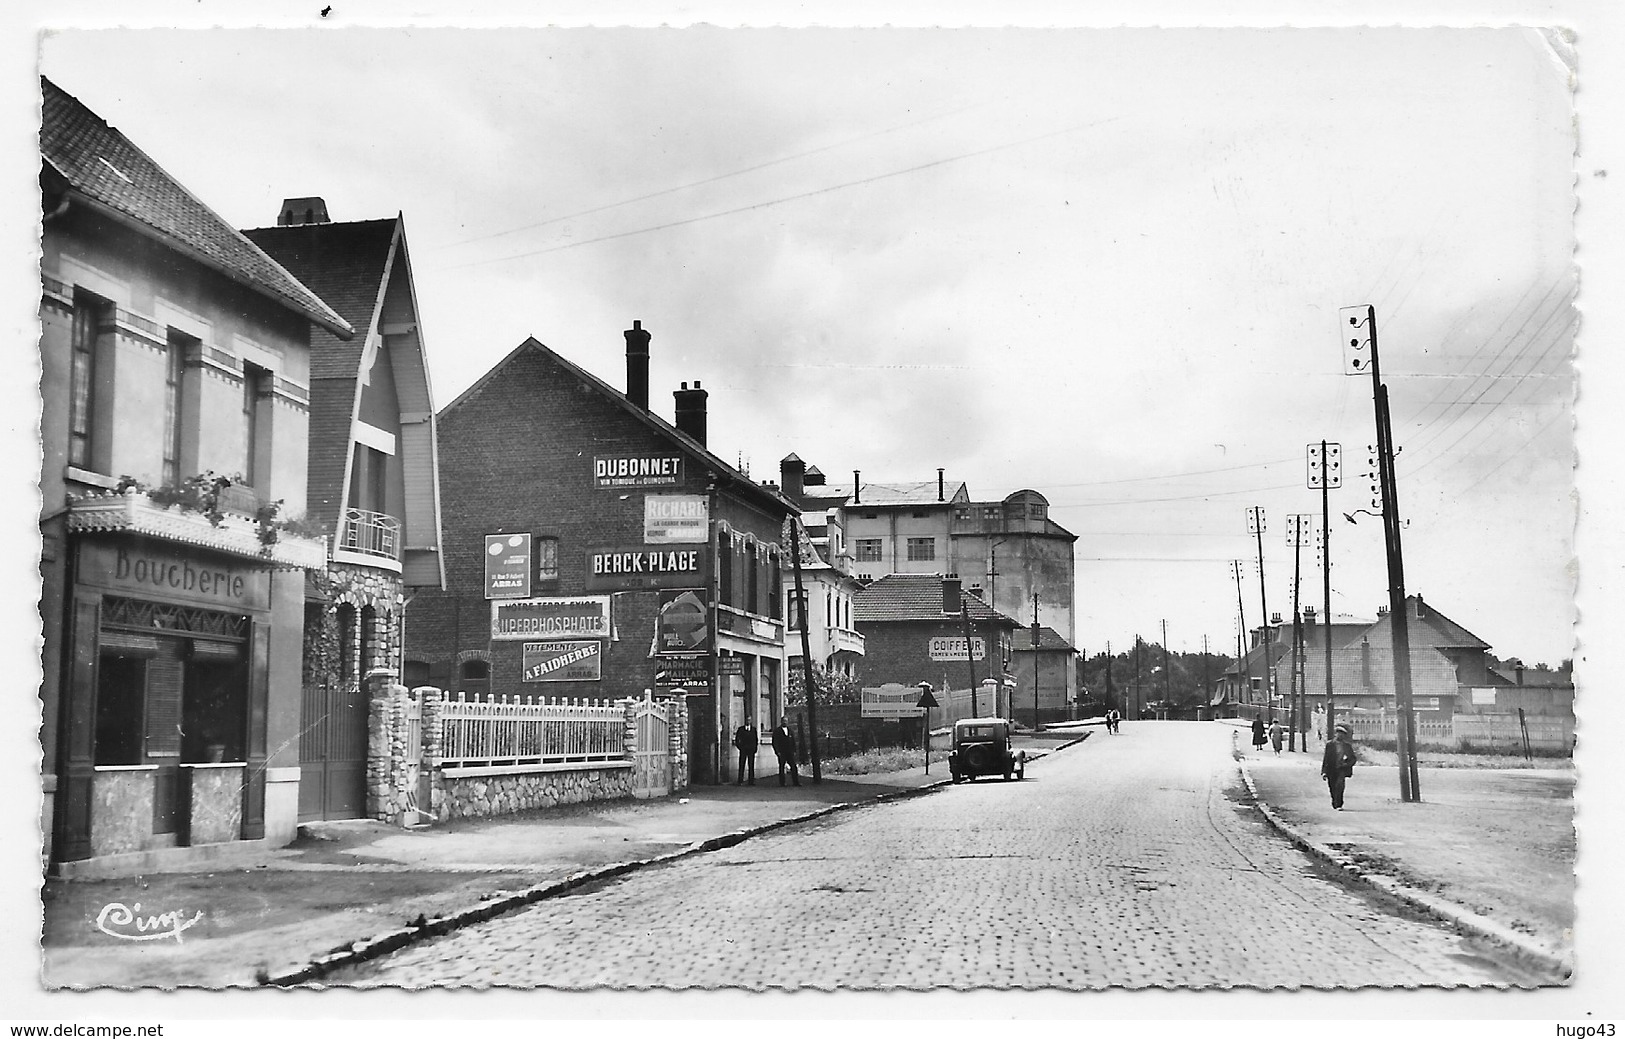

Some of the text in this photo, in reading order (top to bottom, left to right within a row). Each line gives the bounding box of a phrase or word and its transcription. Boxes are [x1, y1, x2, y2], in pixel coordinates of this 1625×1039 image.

[596, 457, 680, 477] DUBONNET
[648, 500, 706, 517] RICHARD
[594, 550, 698, 574] BERCK-PLAGE
[115, 548, 244, 598] Boucherie
[491, 580, 523, 588] ARRAS
[492, 615, 608, 636] SUPERPHOSPHATES
[532, 645, 598, 677] FAIDHERBE
[656, 659, 704, 670] PHARMACIE
[665, 669, 708, 678] MAILLARD
